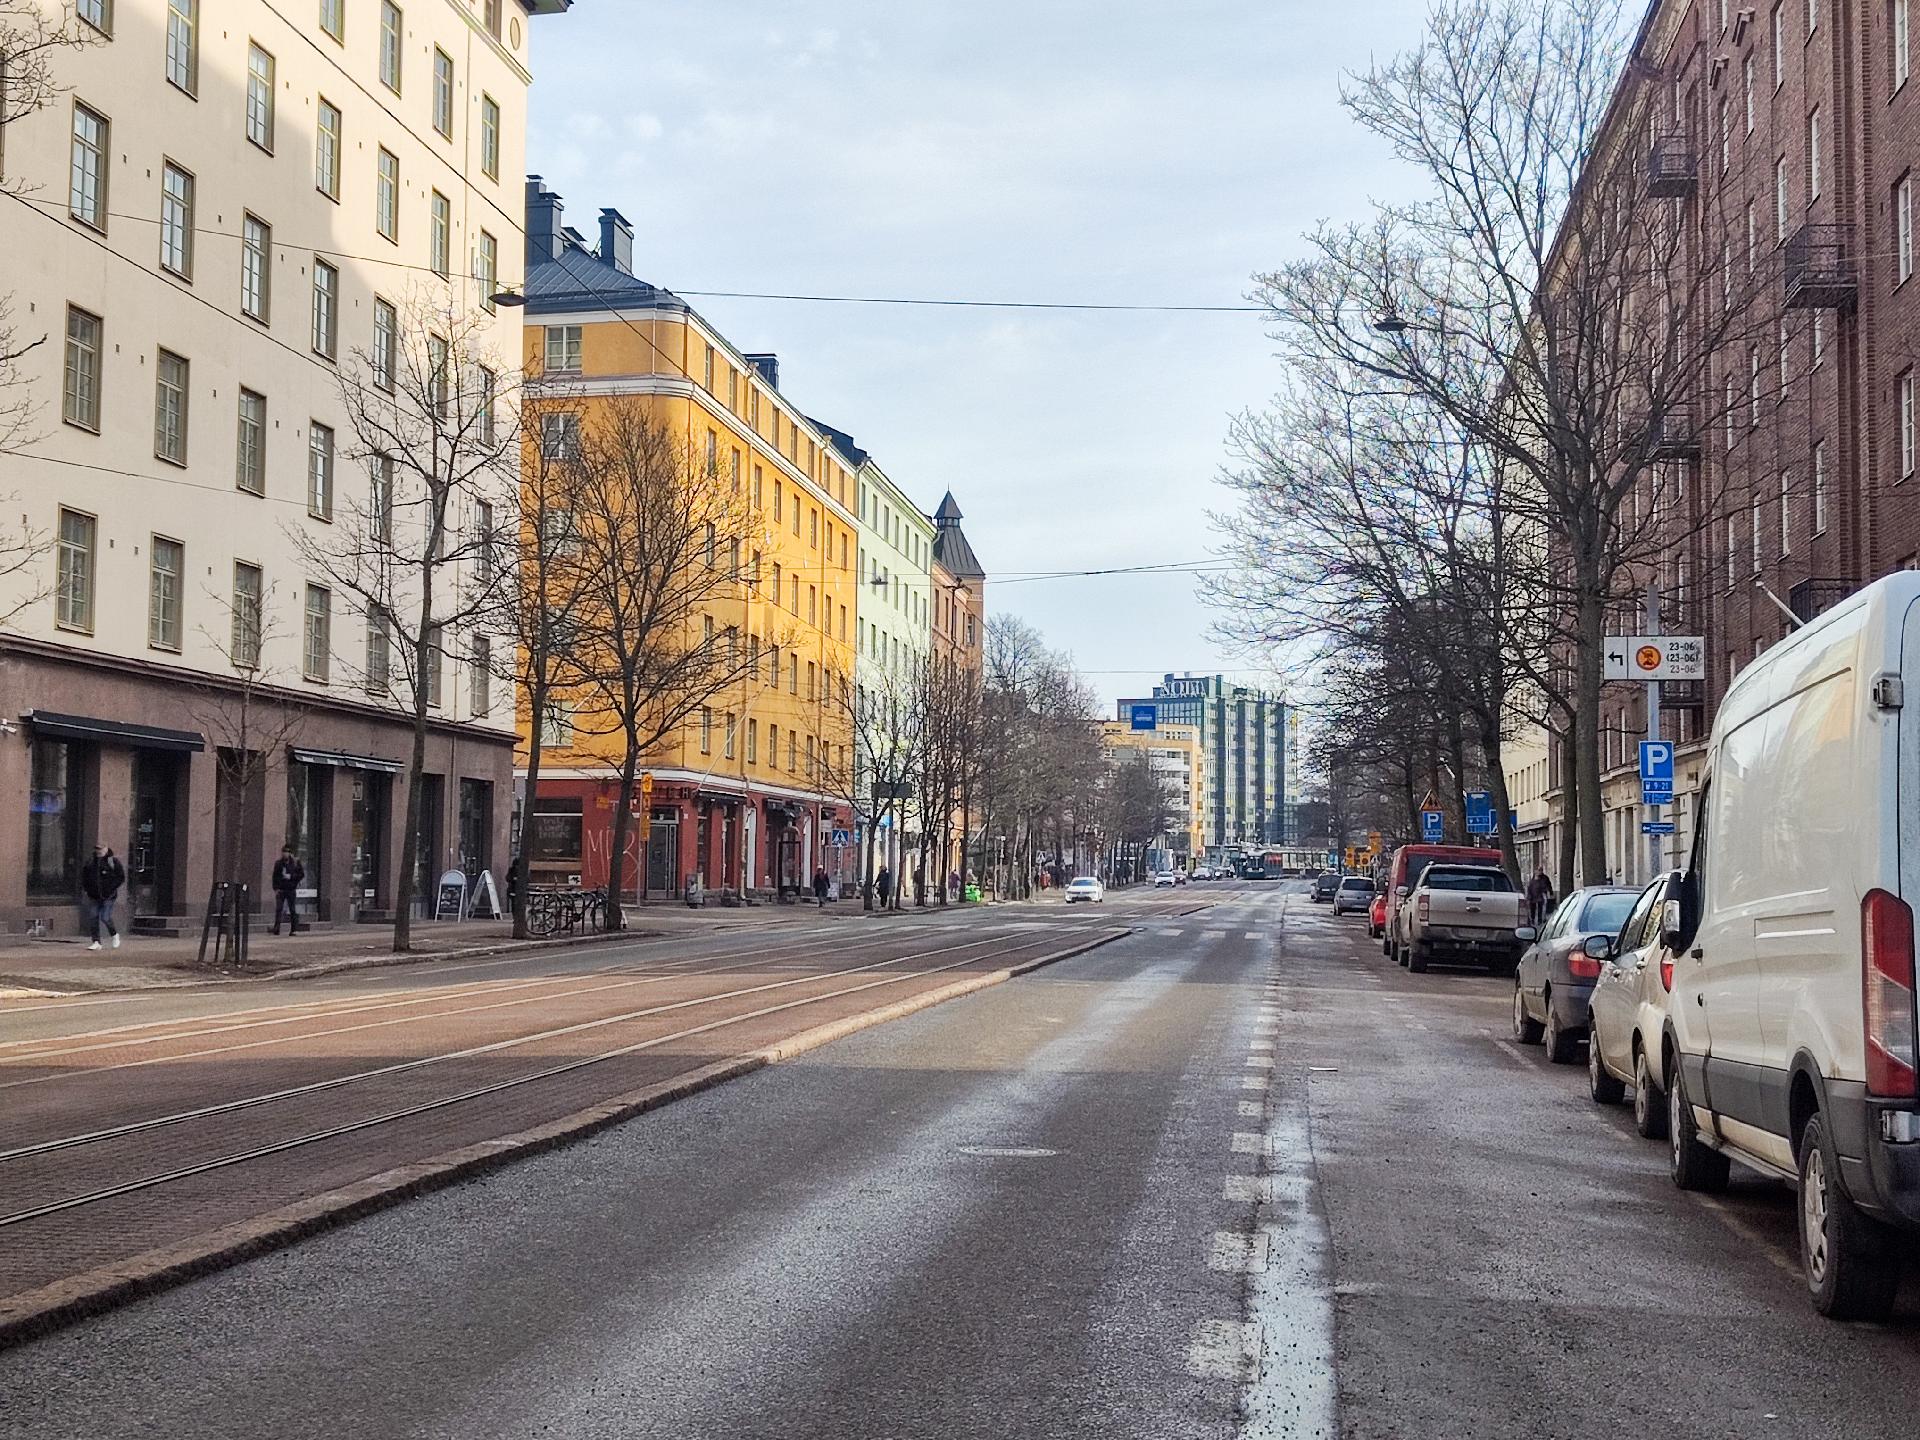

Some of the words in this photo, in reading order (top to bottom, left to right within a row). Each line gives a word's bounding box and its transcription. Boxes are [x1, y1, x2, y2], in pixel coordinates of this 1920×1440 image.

[1669, 642, 1695, 651] 23-06
[1666, 653, 1699, 662] (23-06)
[1670, 664, 1696, 673] 23-06
[1646, 744, 1669, 776] P
[1427, 813, 1439, 828] P
